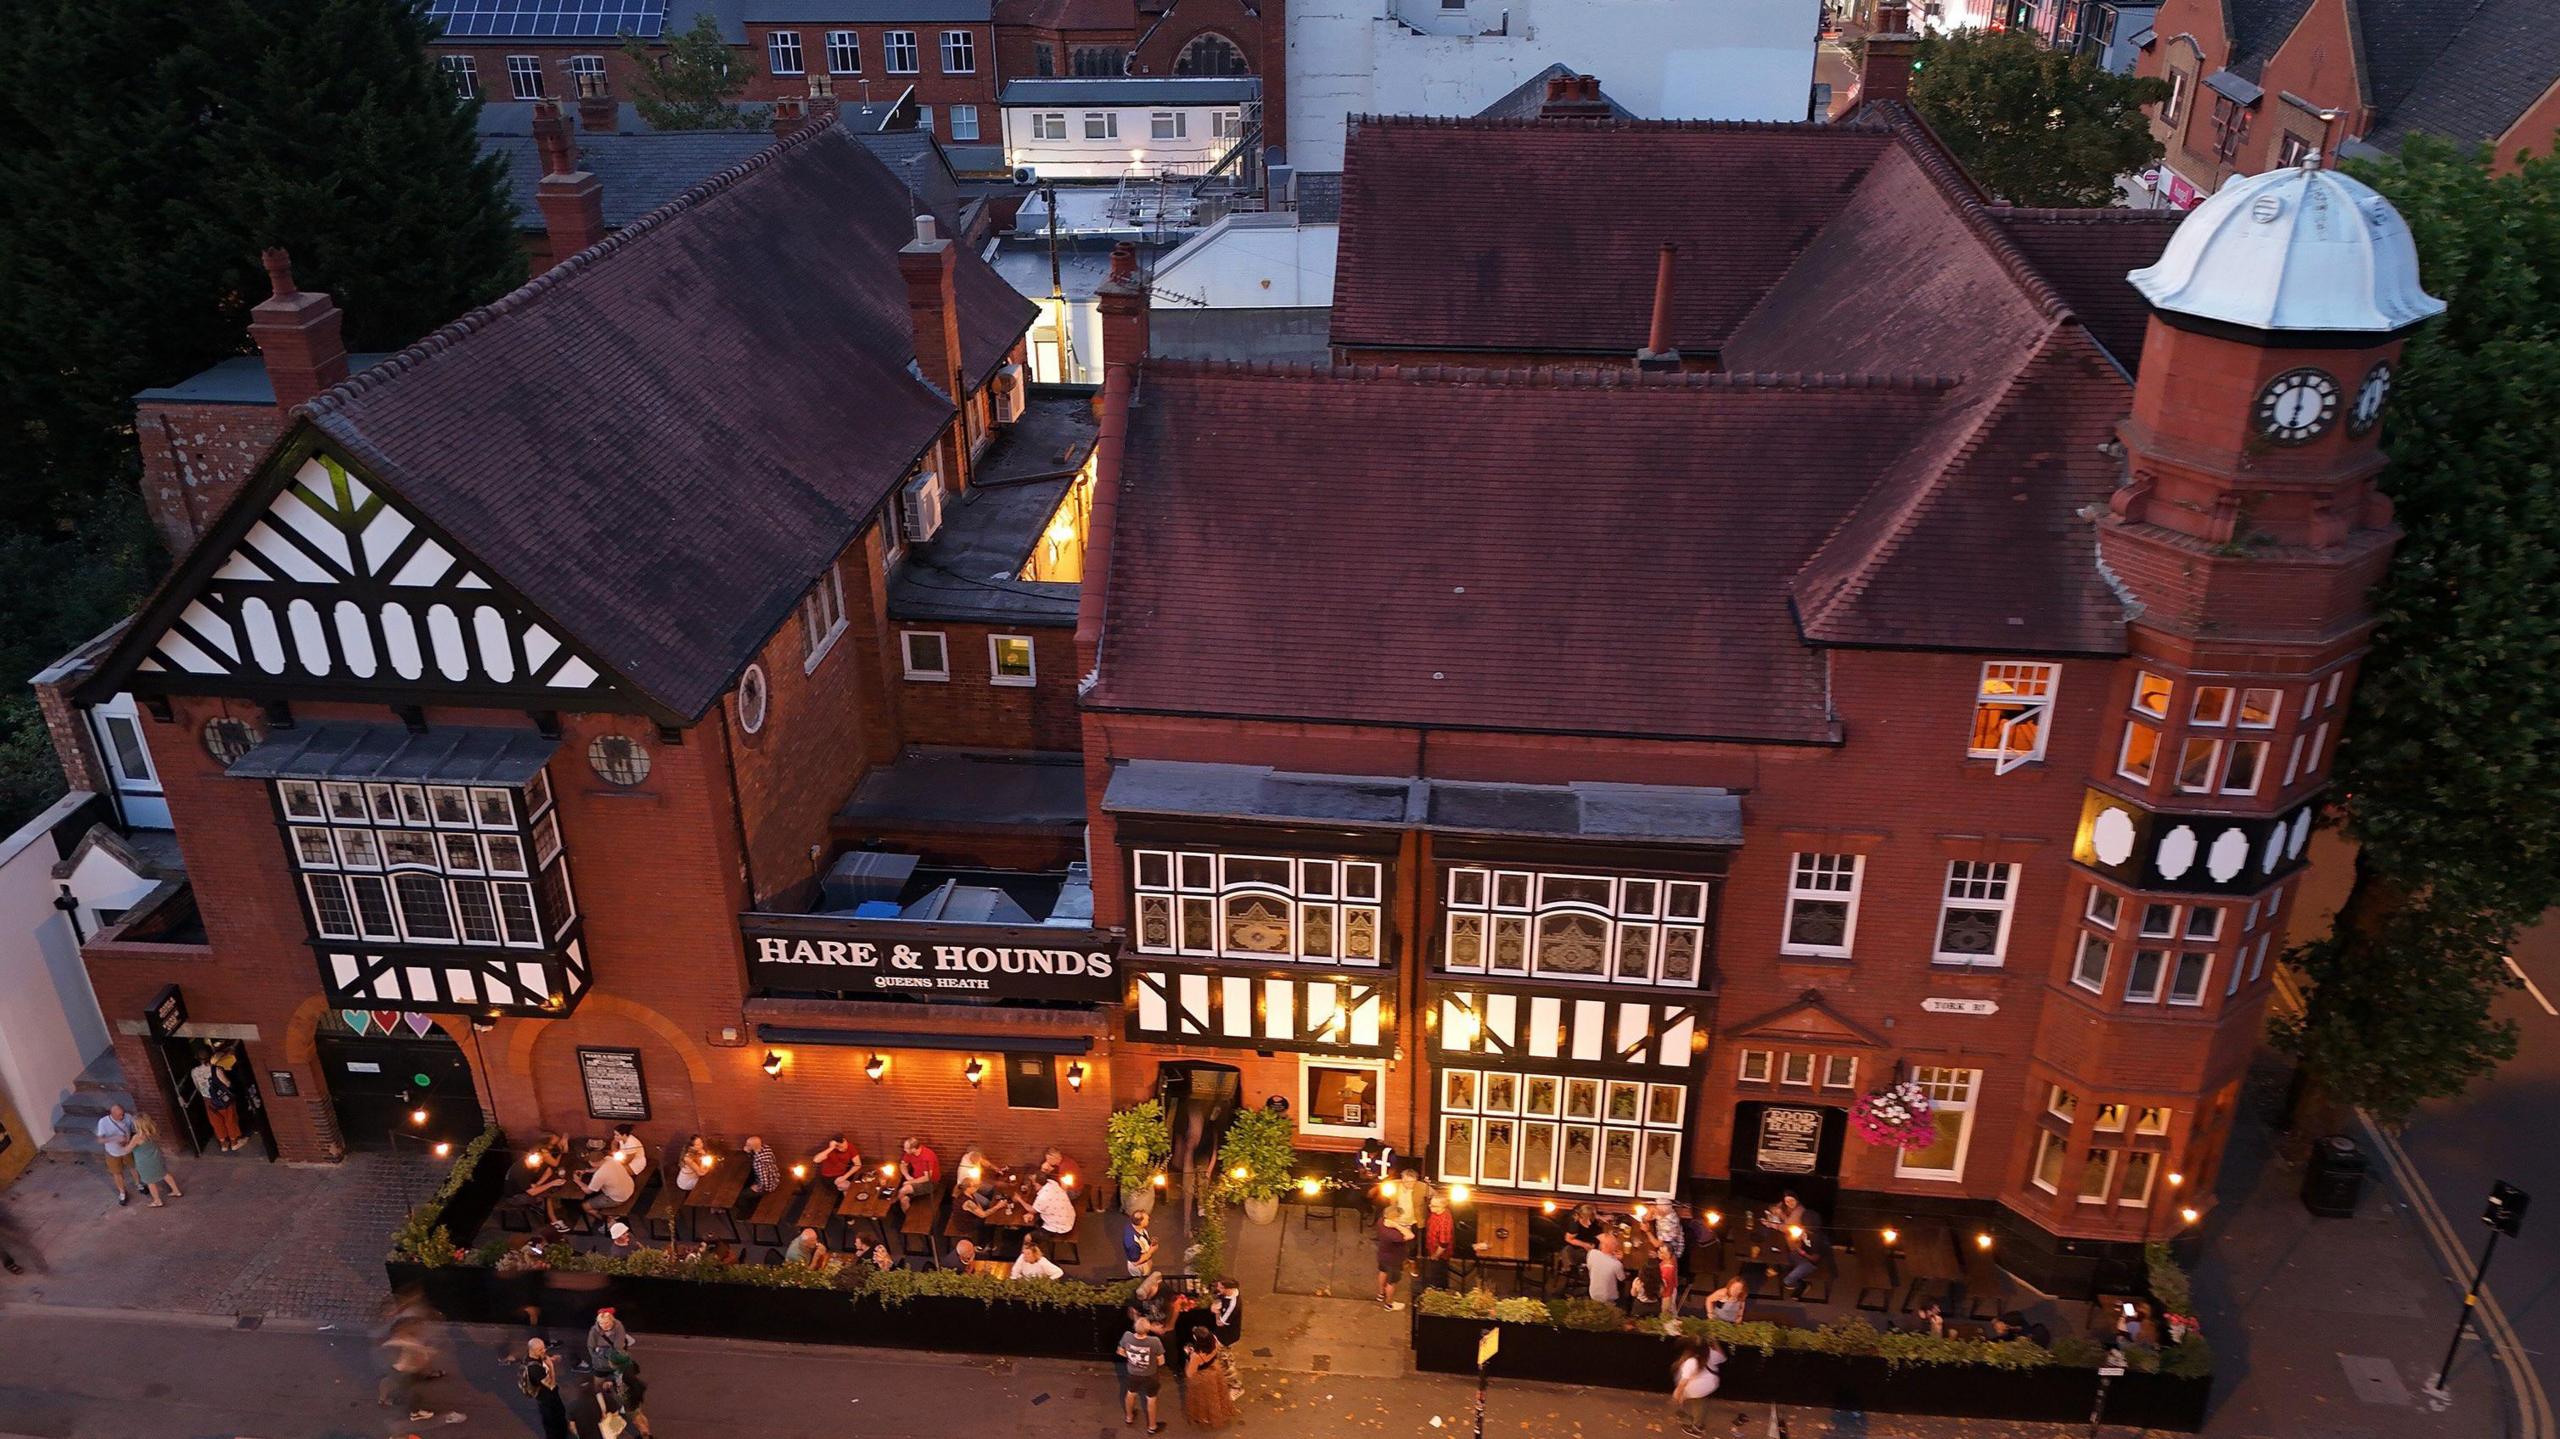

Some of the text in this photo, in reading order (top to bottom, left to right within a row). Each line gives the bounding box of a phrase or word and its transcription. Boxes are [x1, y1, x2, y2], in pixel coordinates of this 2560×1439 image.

[756, 938, 1113, 978] HARE & HOUNDS
[874, 976, 990, 990] QUEENS HEATH
[1934, 1001, 1965, 1010] YORK
[1770, 1110, 1816, 1122] FOOD
